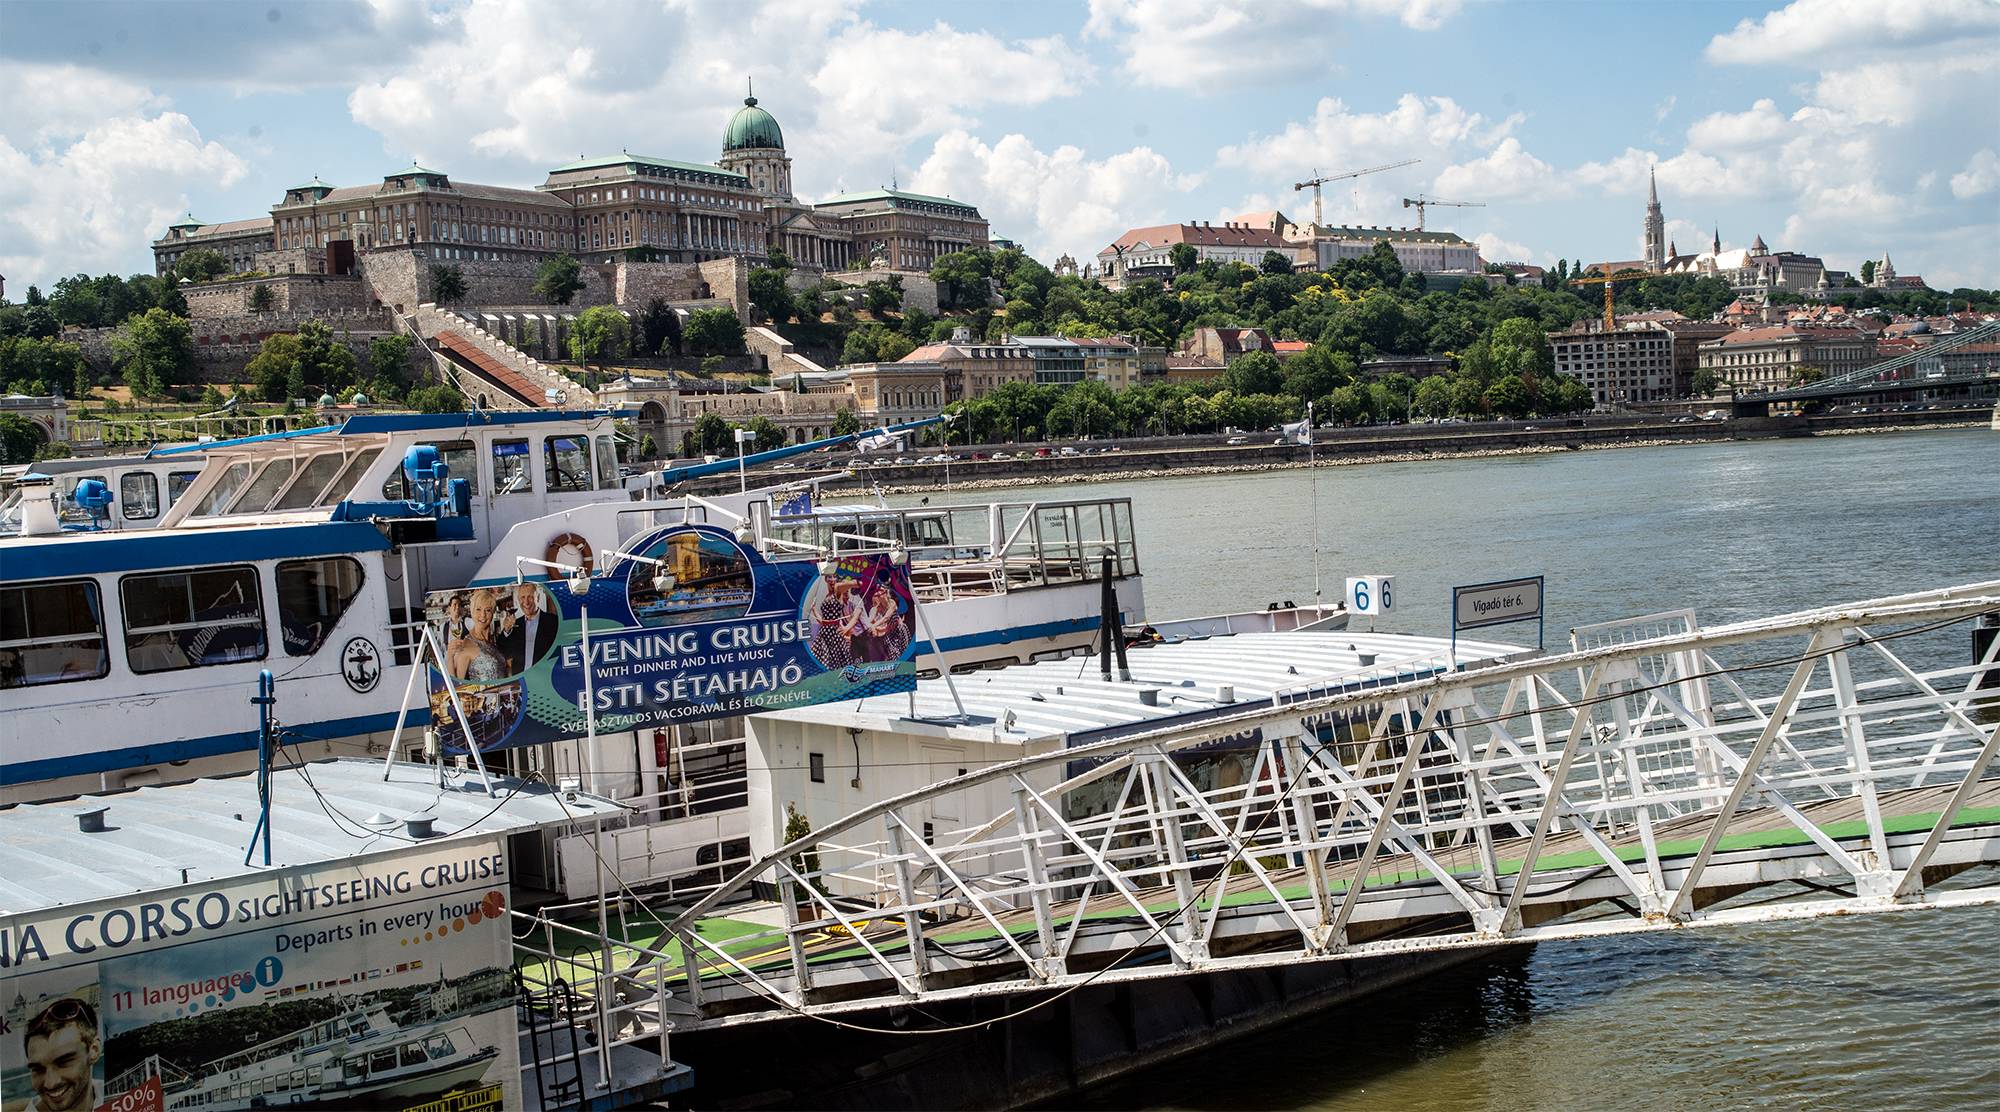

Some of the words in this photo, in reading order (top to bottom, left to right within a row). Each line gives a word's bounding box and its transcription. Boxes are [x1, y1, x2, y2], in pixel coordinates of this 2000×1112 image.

[1354, 580, 1370, 611] 6
[1381, 580, 1392, 609] 6
[1473, 595, 1501, 615] Vigadó
[1502, 594, 1514, 608] tér
[1515, 594, 1524, 607] 6.
[561, 631, 699, 668] EVENING
[711, 619, 812, 650] CRUISE
[597, 666, 629, 679] WITH
[633, 659, 678, 674] DINNER
[681, 656, 706, 669] AND
[710, 653, 734, 665] LIVE
[738, 648, 774, 662] MUSIC
[577, 683, 644, 712] ESTI
[653, 657, 803, 702] SÉTAHAJÓ
[654, 699, 727, 719] VACSORÁVAL
[729, 697, 741, 710] ÉS
[744, 695, 764, 709] ÉLŐ
[766, 690, 812, 705] ZENÉVEL
[65, 892, 230, 954] CORSO
[238, 871, 411, 923] SIGHTSEEING
[420, 854, 505, 888] CRUISE
[275, 924, 353, 953] Departs
[359, 918, 377, 937] in
[384, 909, 434, 930] every
[440, 899, 482, 921] hour
[113, 990, 132, 1012] 11
[143, 970, 252, 1006] languages
[111, 1084, 156, 1112] 50%
